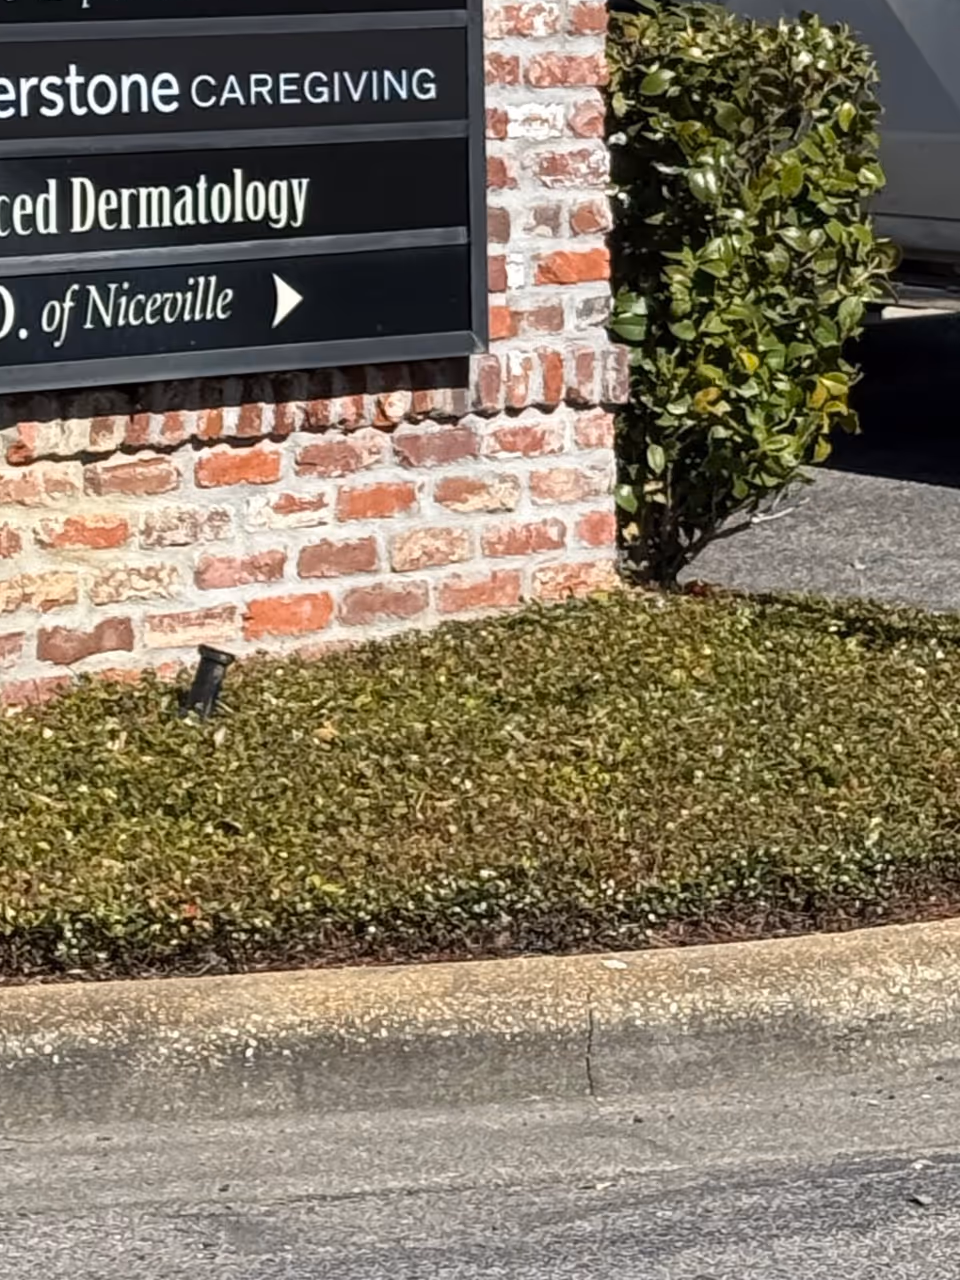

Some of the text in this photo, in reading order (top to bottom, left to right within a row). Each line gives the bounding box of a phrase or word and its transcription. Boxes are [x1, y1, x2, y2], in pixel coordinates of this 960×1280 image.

[190, 67, 438, 109] CAREGIVING
[70, 168, 311, 230] Dermatology
[40, 283, 81, 348] of
[82, 273, 235, 330] Niceville
